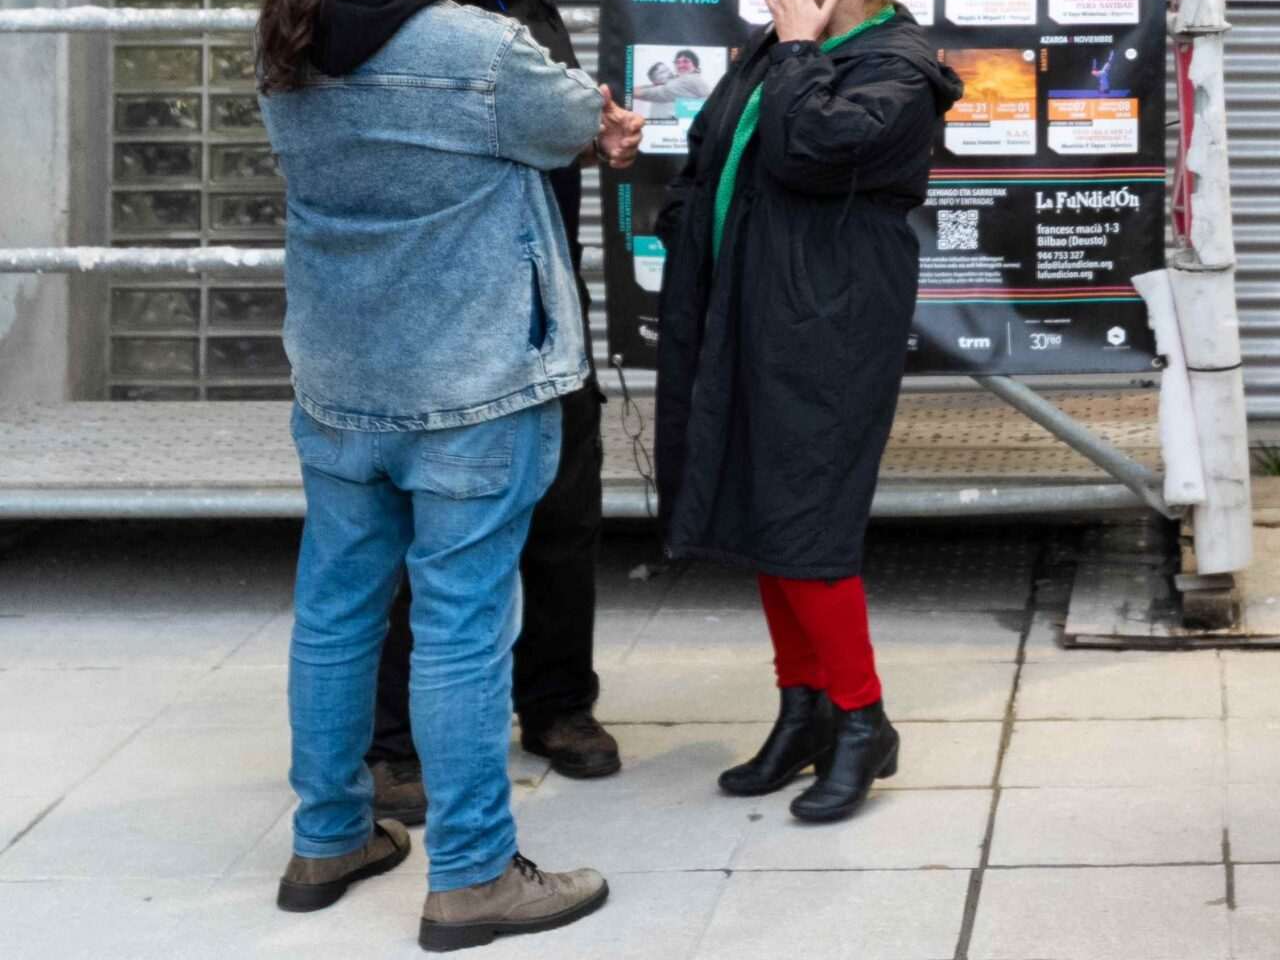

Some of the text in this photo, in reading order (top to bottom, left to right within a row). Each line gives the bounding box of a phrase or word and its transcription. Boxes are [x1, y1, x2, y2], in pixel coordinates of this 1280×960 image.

[1073, 34, 1114, 43] NOVIEMBRE
[1035, 191, 1054, 209] La
[1036, 224, 1074, 234] francesc
[1104, 223, 1120, 233] 1-3
[1037, 235, 1107, 247] Bilbao (Deusto)
[1037, 270, 1094, 280] lafundicion.org
[957, 335, 992, 349] trm
